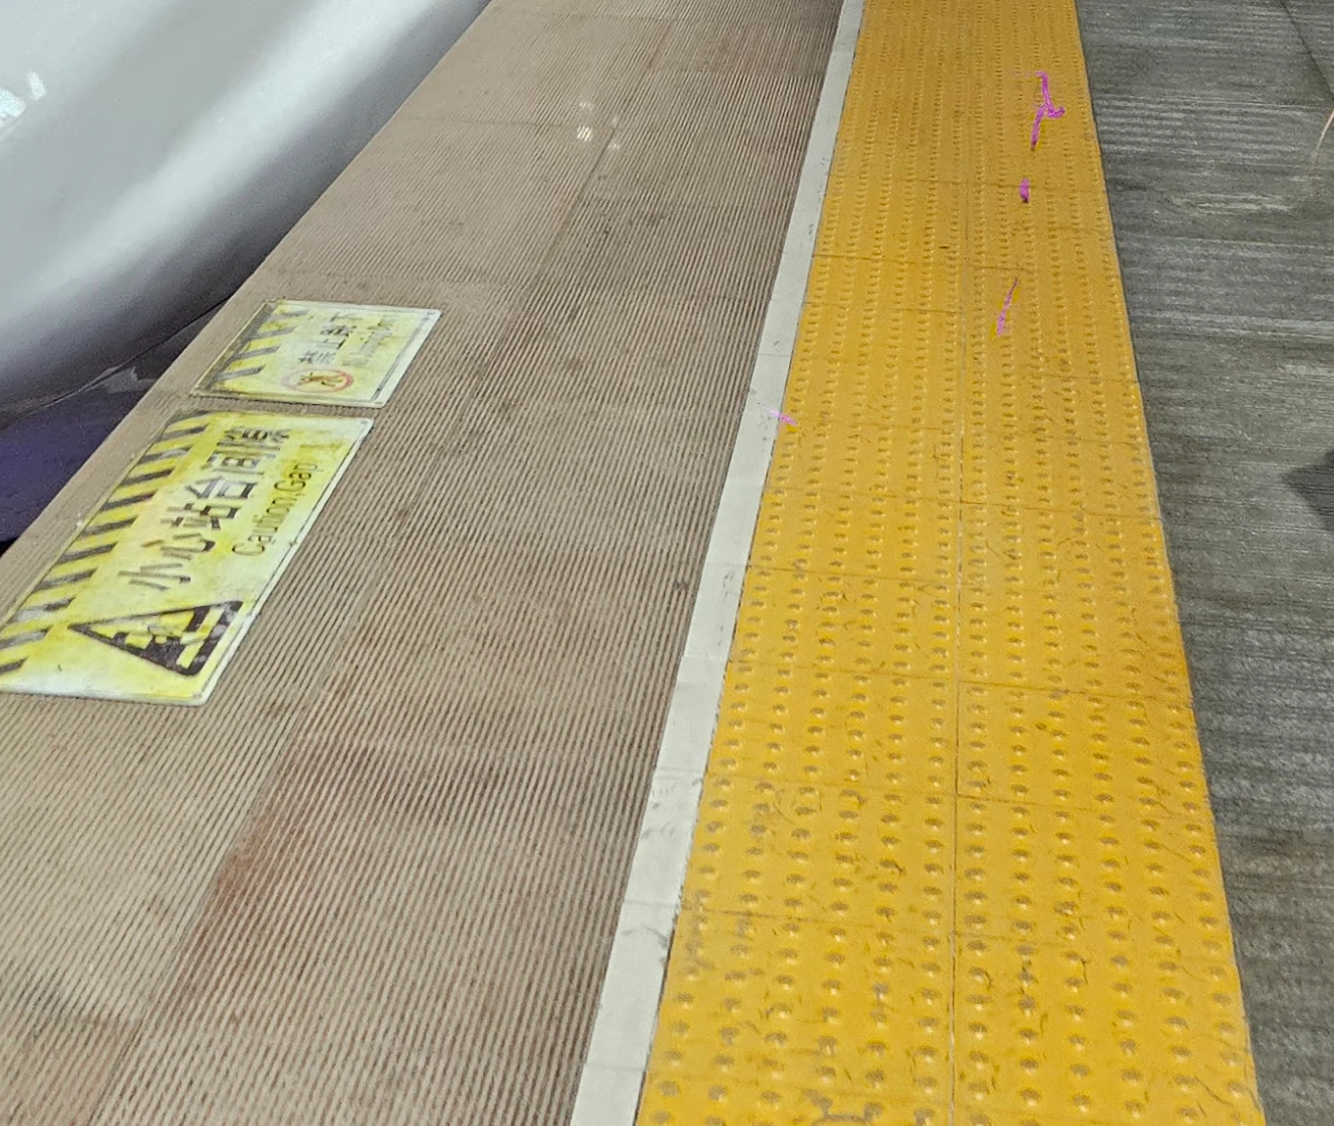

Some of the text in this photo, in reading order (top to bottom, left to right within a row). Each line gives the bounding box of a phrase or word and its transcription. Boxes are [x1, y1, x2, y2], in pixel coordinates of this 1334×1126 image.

[118, 425, 292, 591] 小心站台间隙
